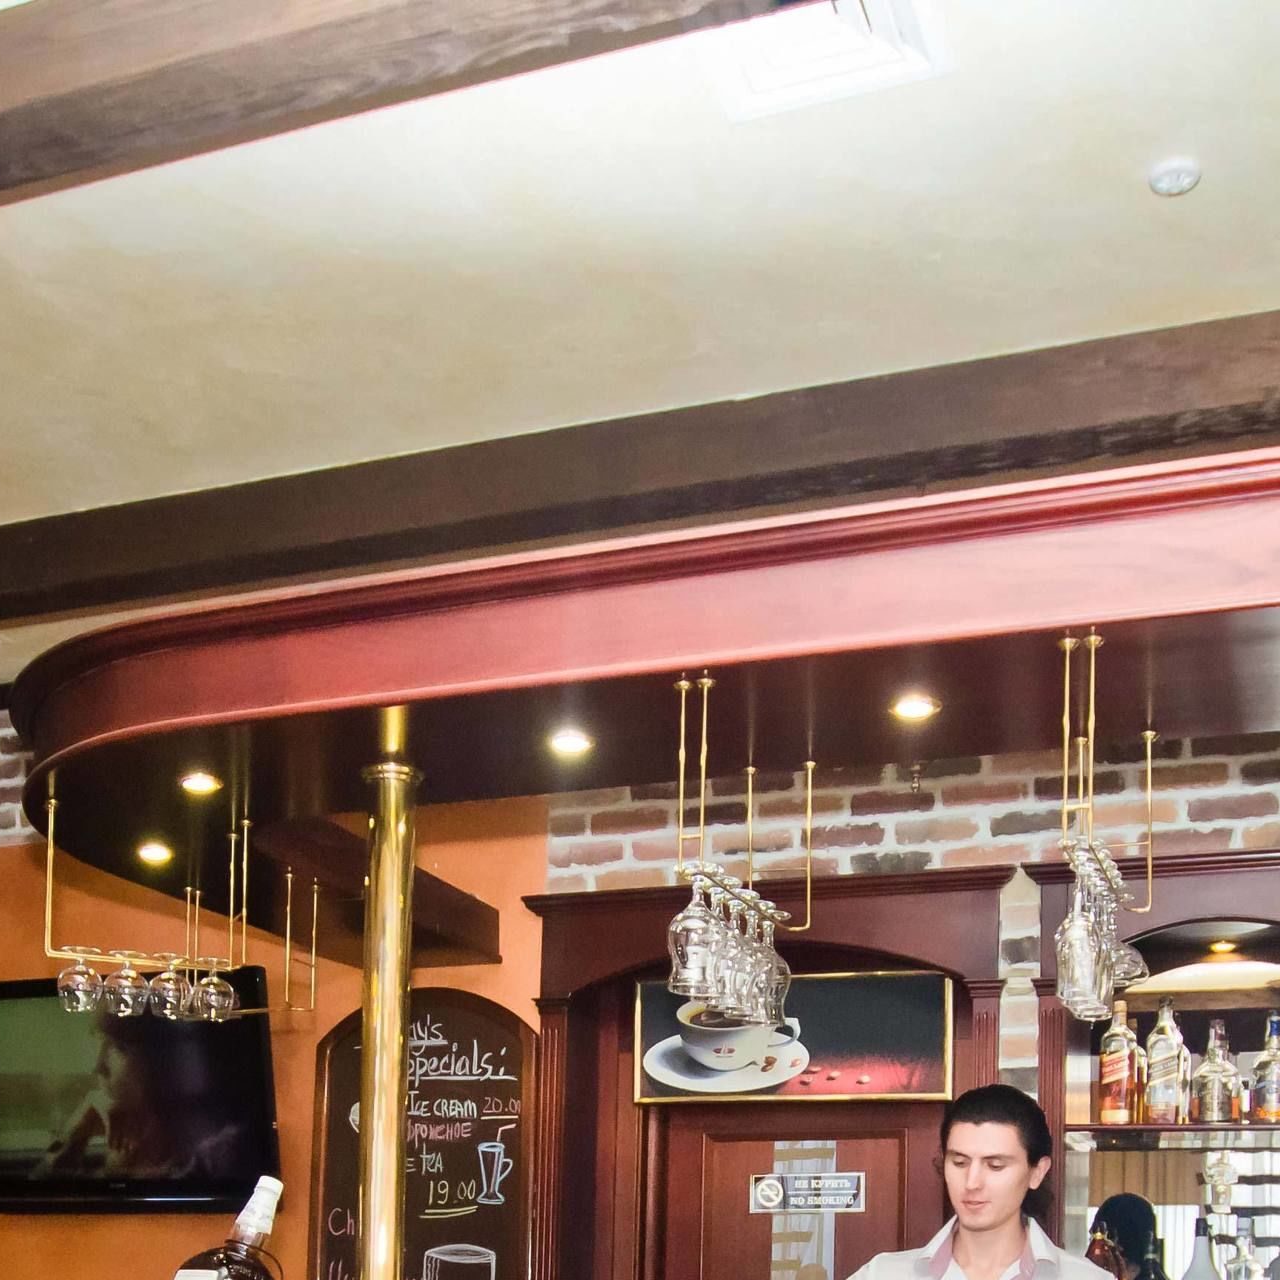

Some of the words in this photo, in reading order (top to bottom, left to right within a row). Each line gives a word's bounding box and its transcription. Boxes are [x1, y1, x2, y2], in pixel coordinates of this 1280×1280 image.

[433, 1098, 477, 1119] CREAM
[790, 1196, 805, 1205] NO
[807, 1195, 854, 1206] SMOKING
